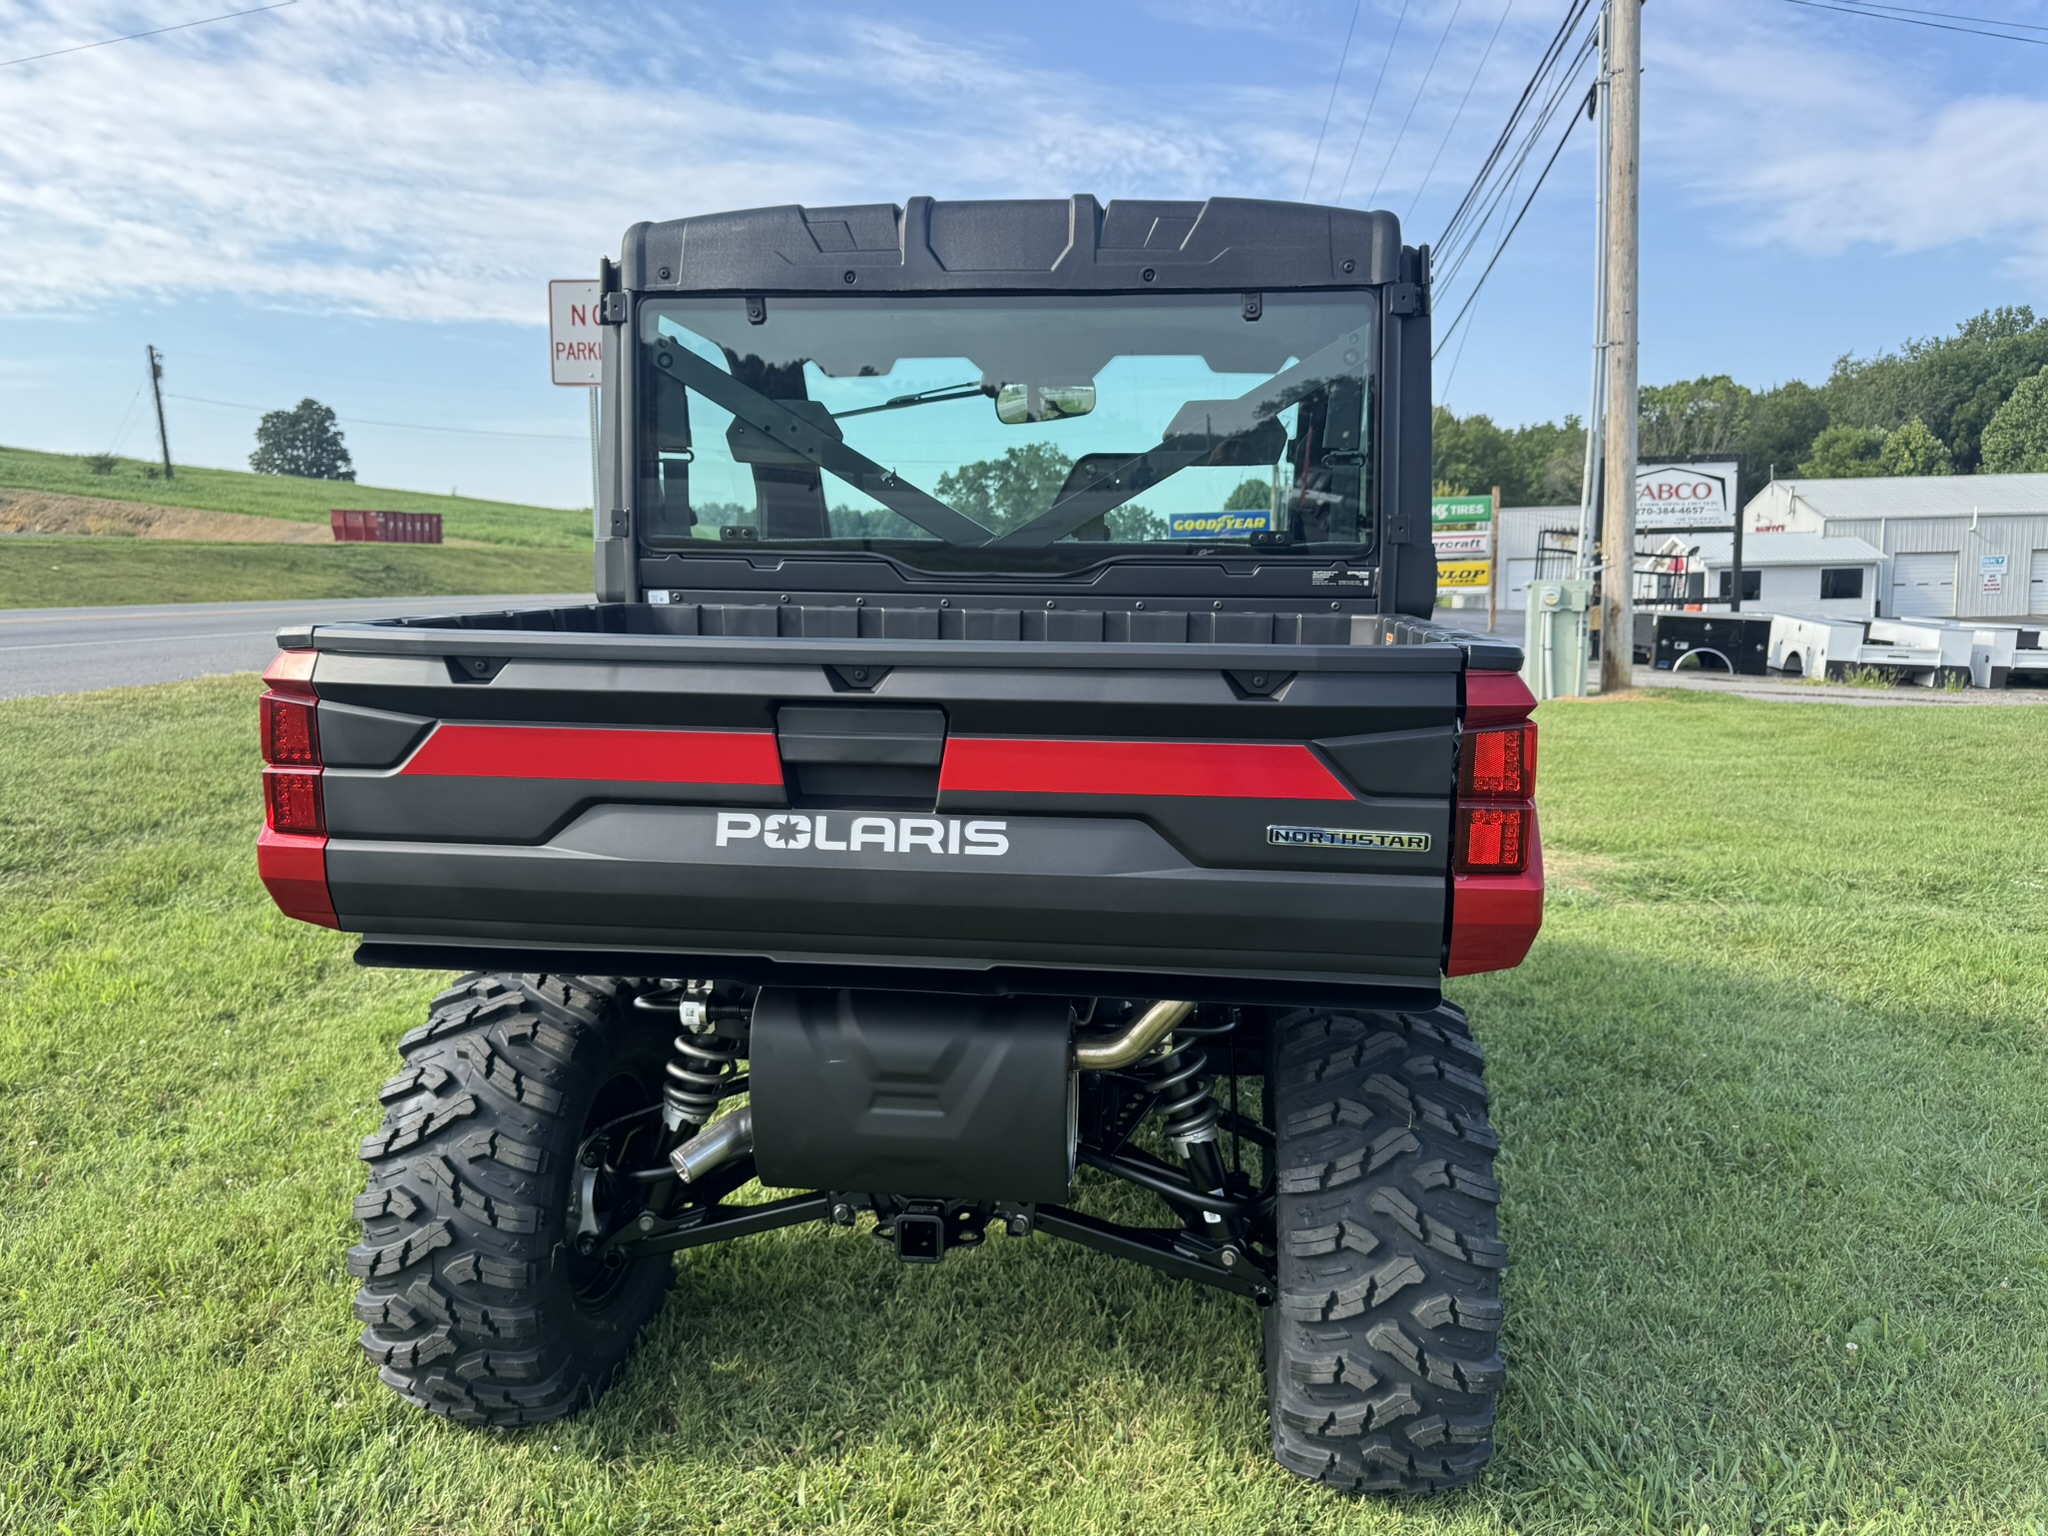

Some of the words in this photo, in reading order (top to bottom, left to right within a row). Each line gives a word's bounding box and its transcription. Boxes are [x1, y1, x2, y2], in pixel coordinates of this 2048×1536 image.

[555, 341, 602, 361] PARKI
[1449, 504, 1485, 515] TIRES
[1173, 516, 1266, 532] GOODYEAR
[1437, 569, 1485, 579] NLOP
[715, 812, 1009, 856] POLARIS
[1273, 829, 1423, 849] NORTHSTAR
